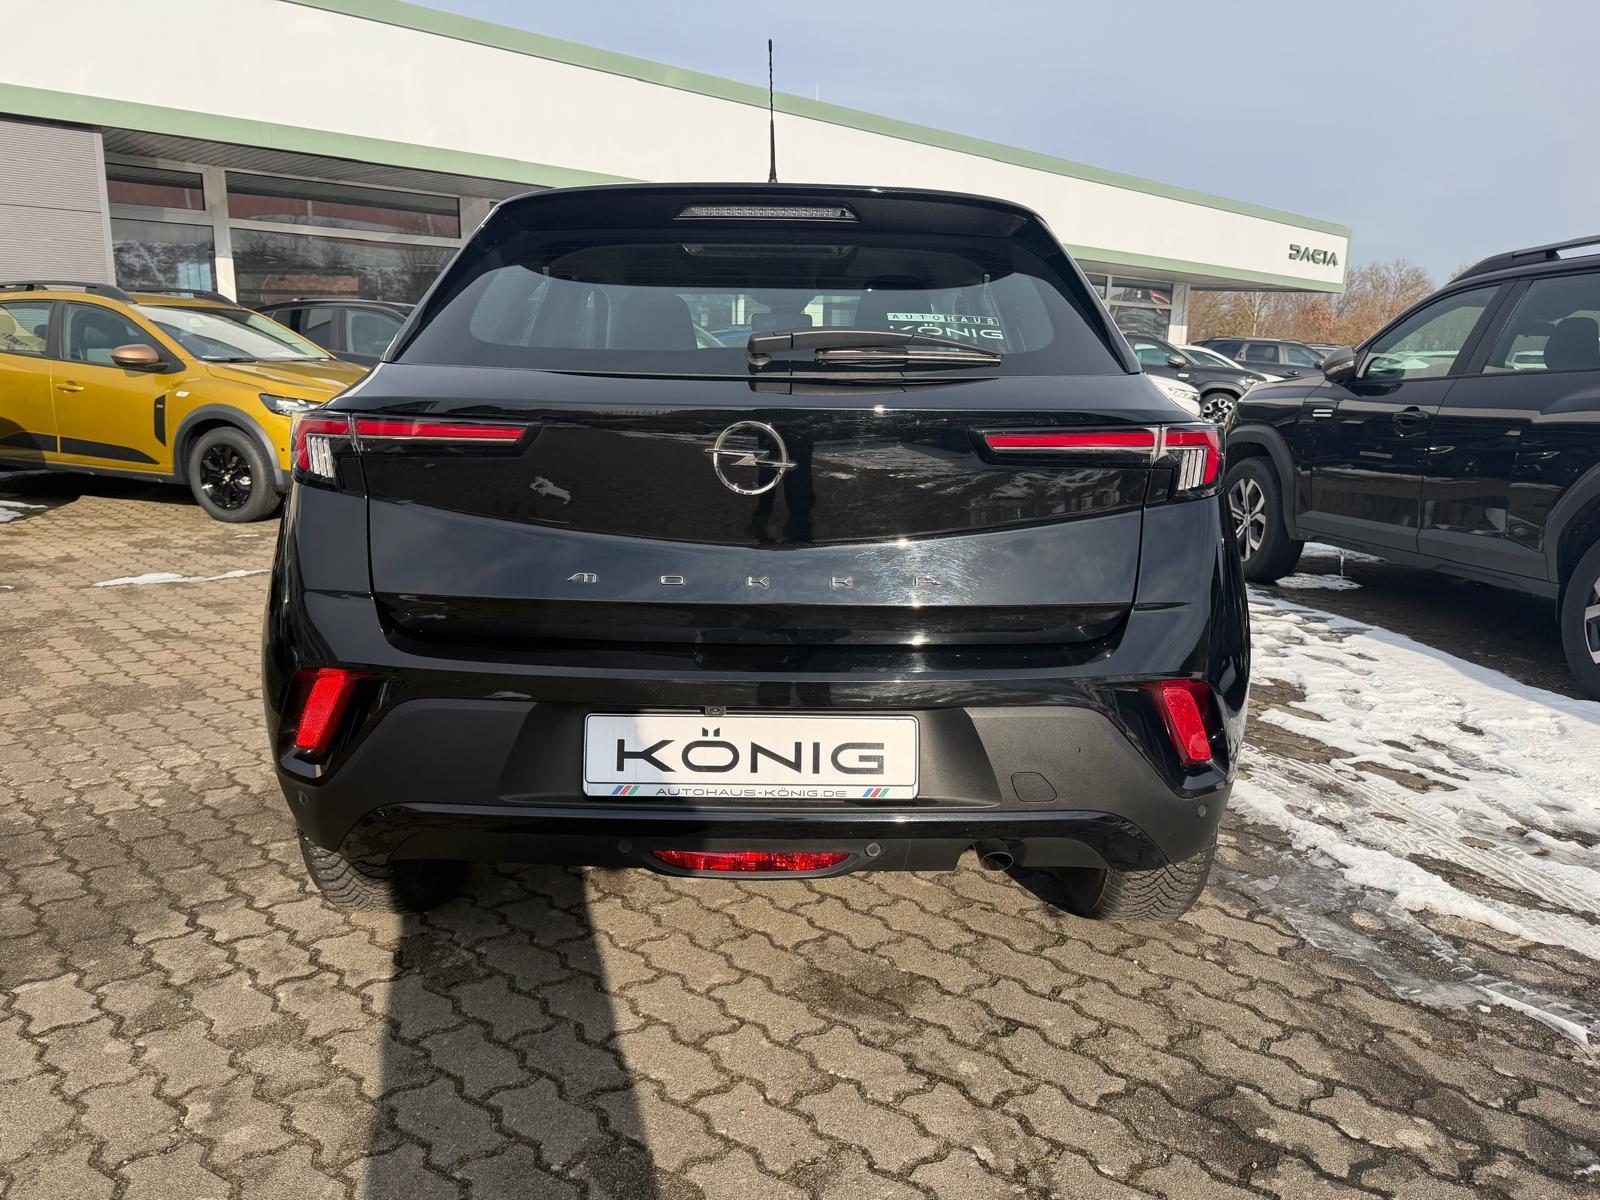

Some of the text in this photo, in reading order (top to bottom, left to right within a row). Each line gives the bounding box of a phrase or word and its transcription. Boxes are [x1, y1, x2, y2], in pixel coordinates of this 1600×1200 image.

[1288, 244, 1339, 267] DACIA
[888, 312, 998, 326] AUTOHAUS
[566, 571, 942, 588] MOKKA
[616, 727, 885, 775] KÖNIG
[655, 787, 847, 798] AUTOHAUS-KÖNIG.DE
